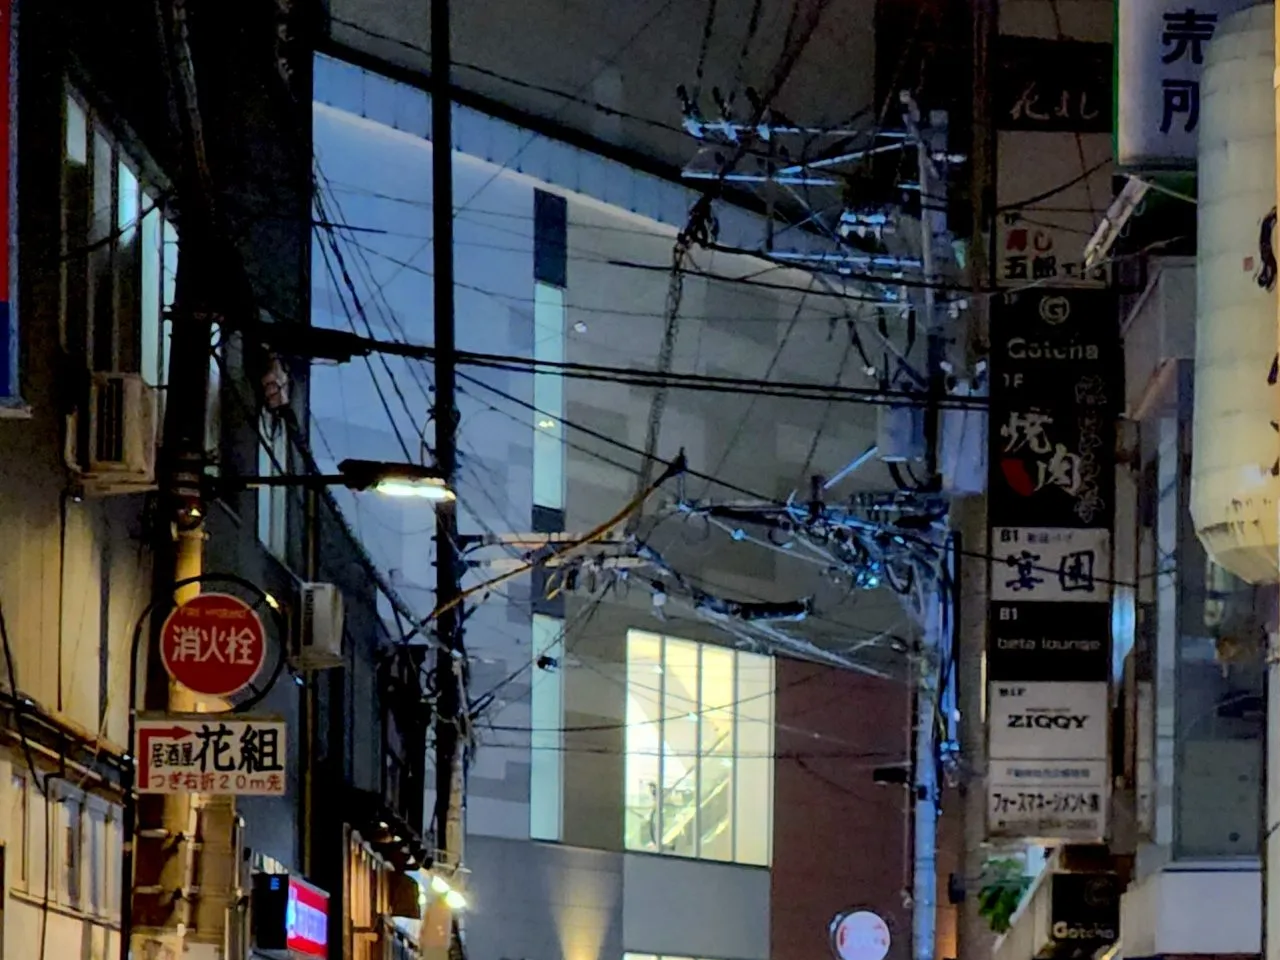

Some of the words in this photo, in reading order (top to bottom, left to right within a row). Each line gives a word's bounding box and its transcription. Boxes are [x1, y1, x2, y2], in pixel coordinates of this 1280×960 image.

[172, 624, 256, 666] 消火栓
[152, 742, 194, 768] 居酒屋
[194, 723, 284, 773] 花組
